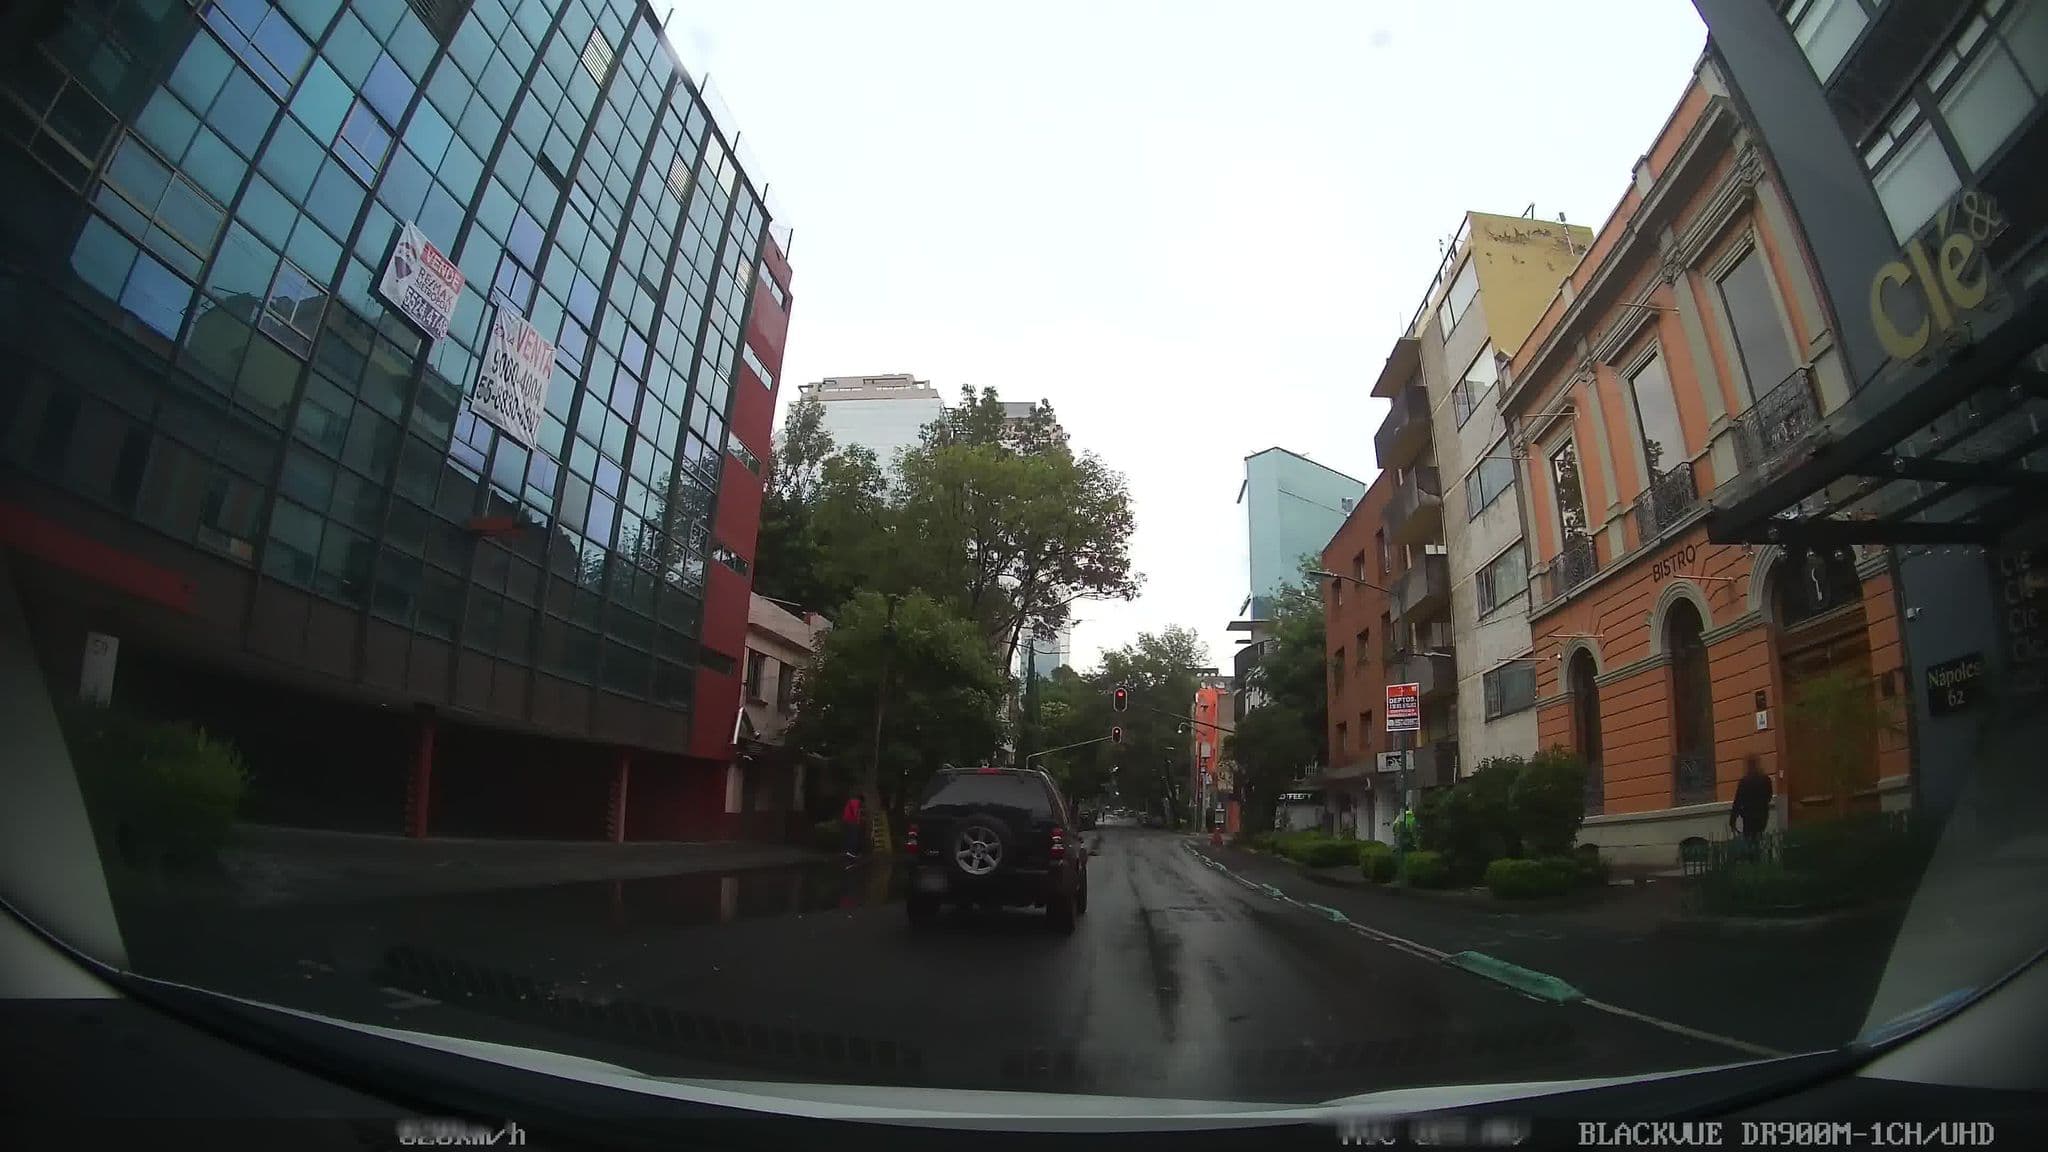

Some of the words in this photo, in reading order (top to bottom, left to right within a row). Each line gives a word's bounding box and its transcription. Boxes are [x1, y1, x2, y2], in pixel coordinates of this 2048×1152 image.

[517, 321, 556, 379] VENTA
[1652, 545, 1696, 583] BISTRO
[1947, 688, 1966, 707] 62
